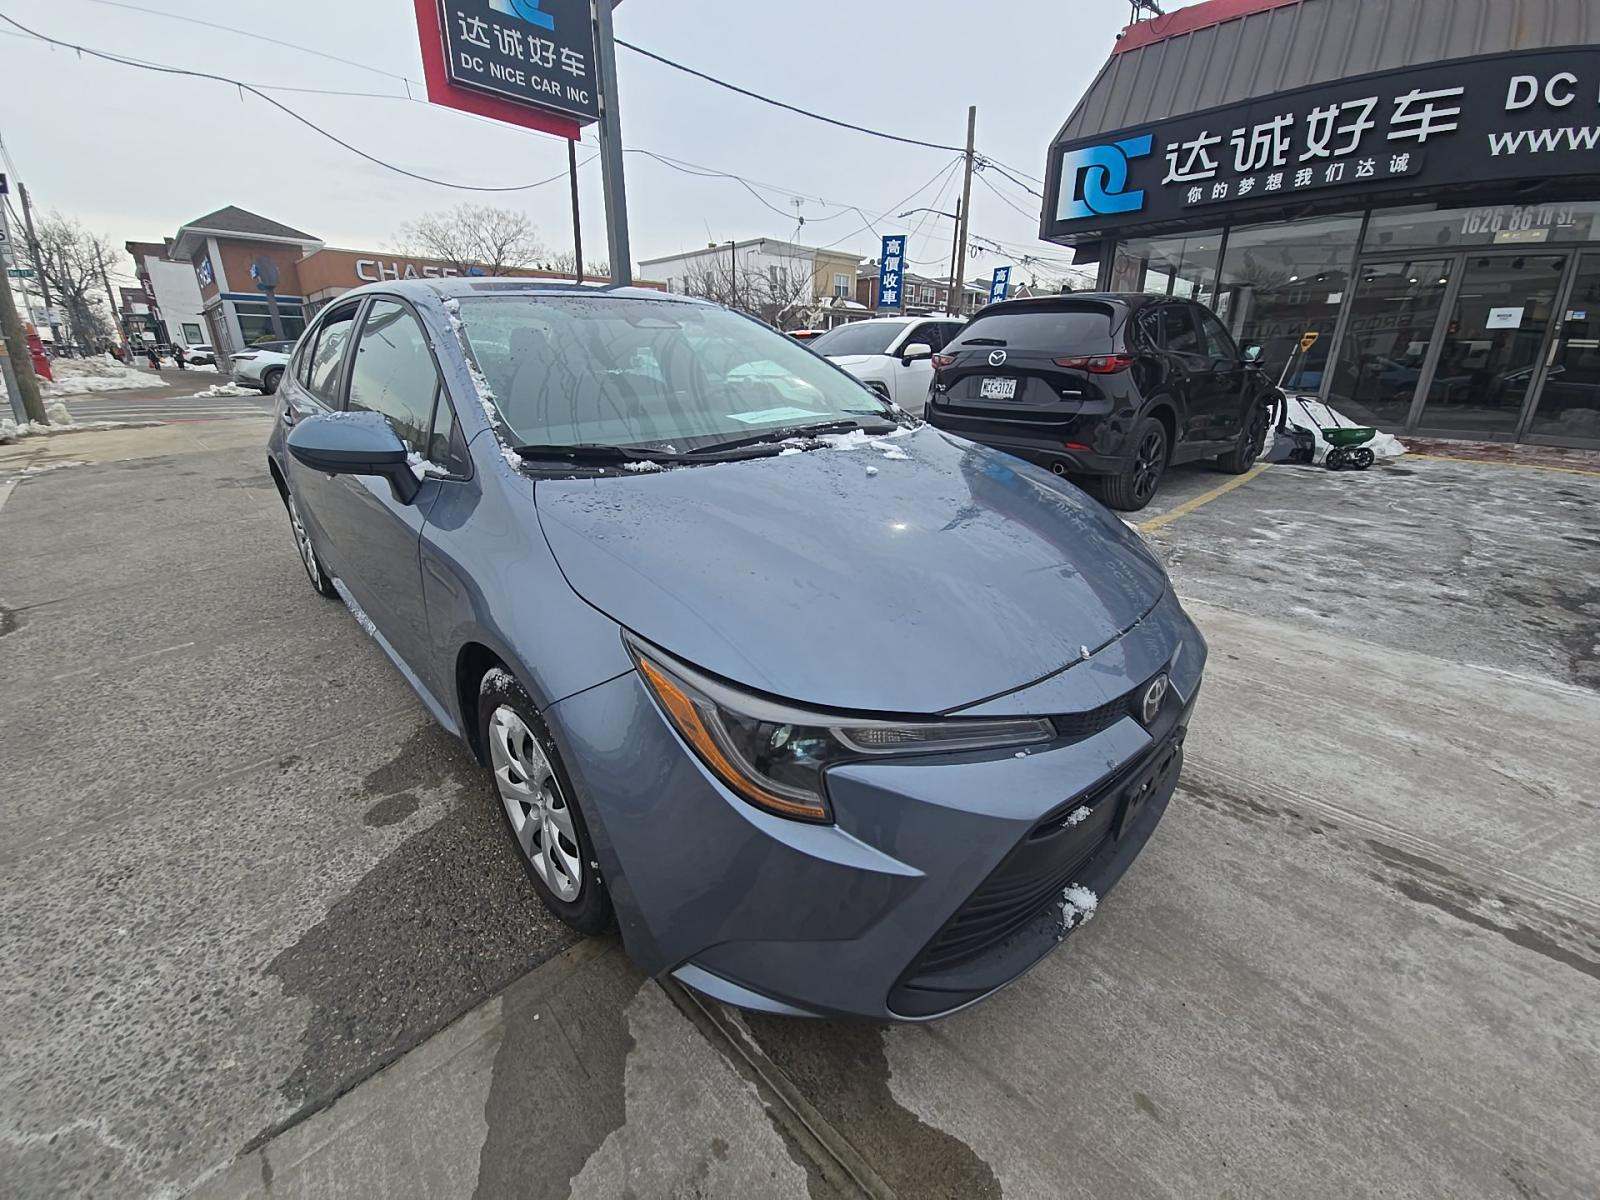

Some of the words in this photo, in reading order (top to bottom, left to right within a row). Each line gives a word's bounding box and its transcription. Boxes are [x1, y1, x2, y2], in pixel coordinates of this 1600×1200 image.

[457, 10, 586, 77] 达诚好车
[460, 52, 484, 73] DC
[489, 62, 526, 86] NICE
[531, 76, 562, 97] CAR
[566, 86, 589, 105] INC
[1505, 72, 1578, 110] DC
[1161, 86, 1465, 185] 达诚好车
[1187, 153, 1410, 204] 你的梦想我们达诚
[1461, 207, 1505, 234] 1626
[355, 259, 458, 282] CHASE
[881, 239, 902, 305] 高價收車
